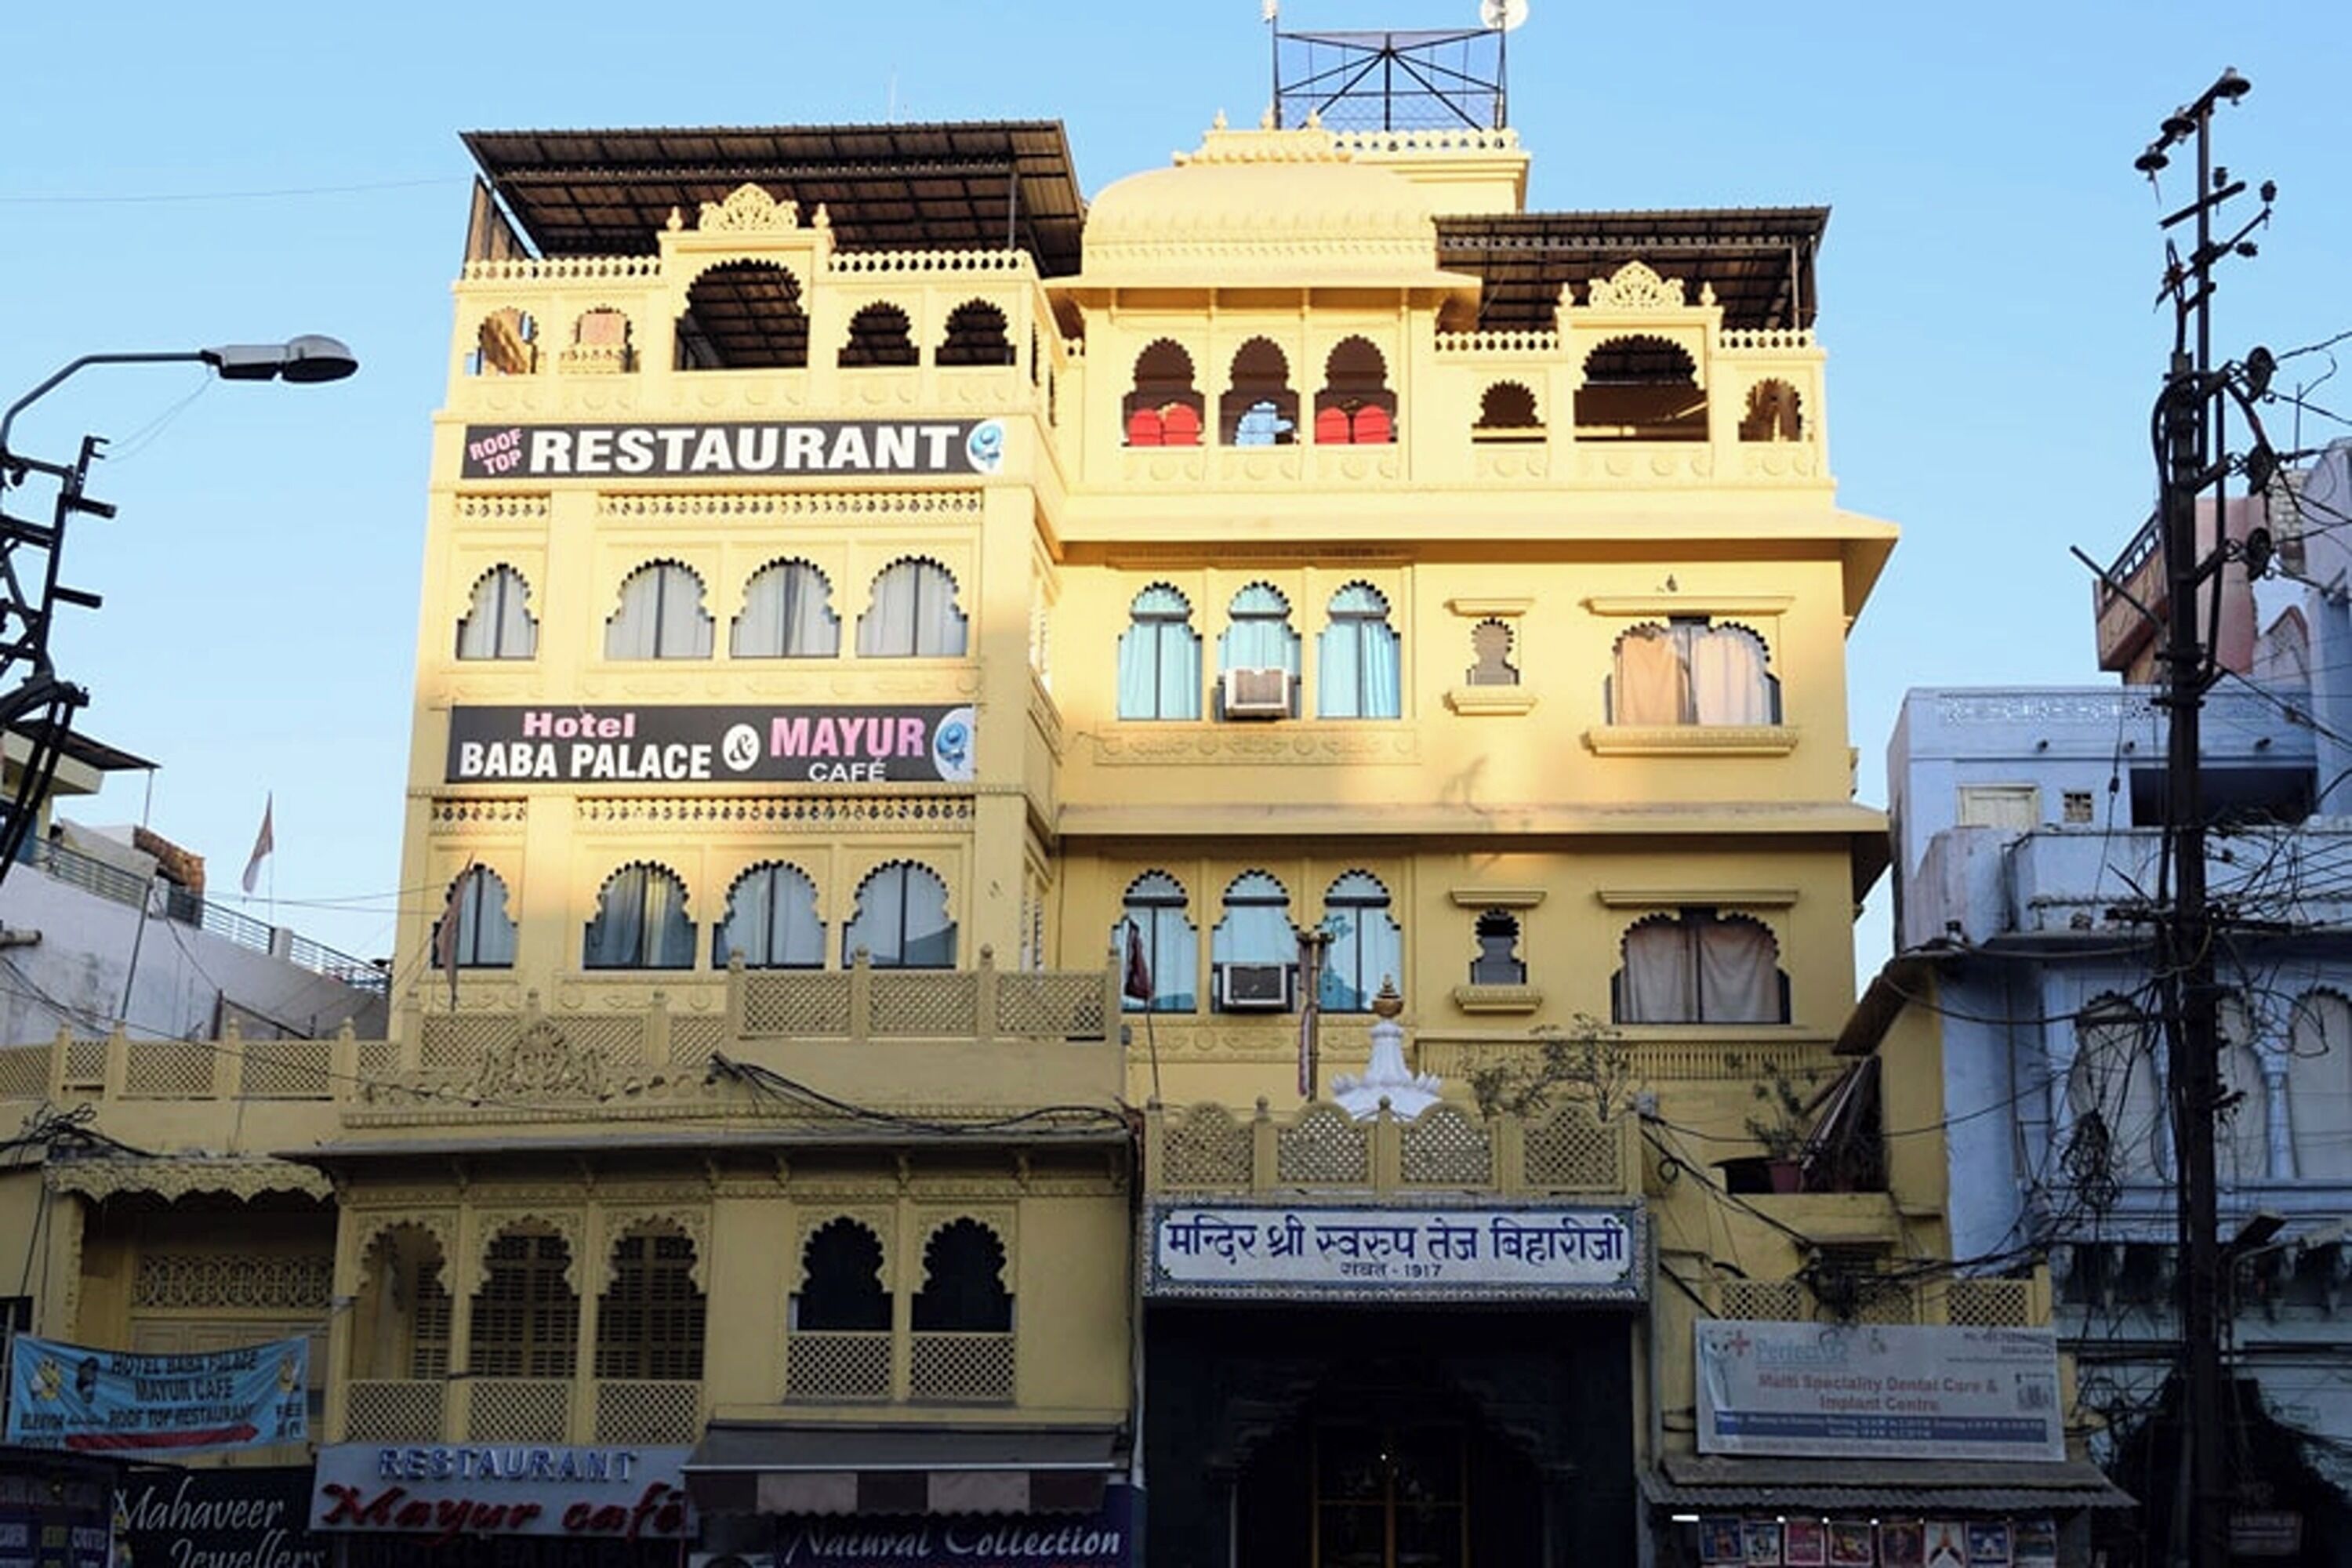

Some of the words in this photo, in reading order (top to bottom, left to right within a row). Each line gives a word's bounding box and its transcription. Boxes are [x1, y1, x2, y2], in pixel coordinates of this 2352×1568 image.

[469, 428, 523, 461] ROOF
[483, 448, 523, 475] TOP
[529, 426, 960, 473] RESTAURANT
[523, 712, 637, 738] Hotel
[770, 717, 926, 757] MAYUR
[459, 741, 558, 779] BABA
[570, 743, 712, 779] PALACE
[808, 757, 887, 782] CAFÉ
[1165, 1214, 1258, 1265] मन्दिर
[1267, 1214, 1305, 1258] श्री
[1426, 1217, 1478, 1261] तेज
[1404, 1263, 1442, 1278] 1917
[1886, 1377, 1938, 1392] Dental
[378, 1448, 637, 1483] RESTAURANT
[113, 1475, 285, 1530] Mahaveer
[322, 1484, 542, 1548] Mayur
[784, 1527, 932, 1566] Natural
[945, 1526, 1121, 1557] Collection
